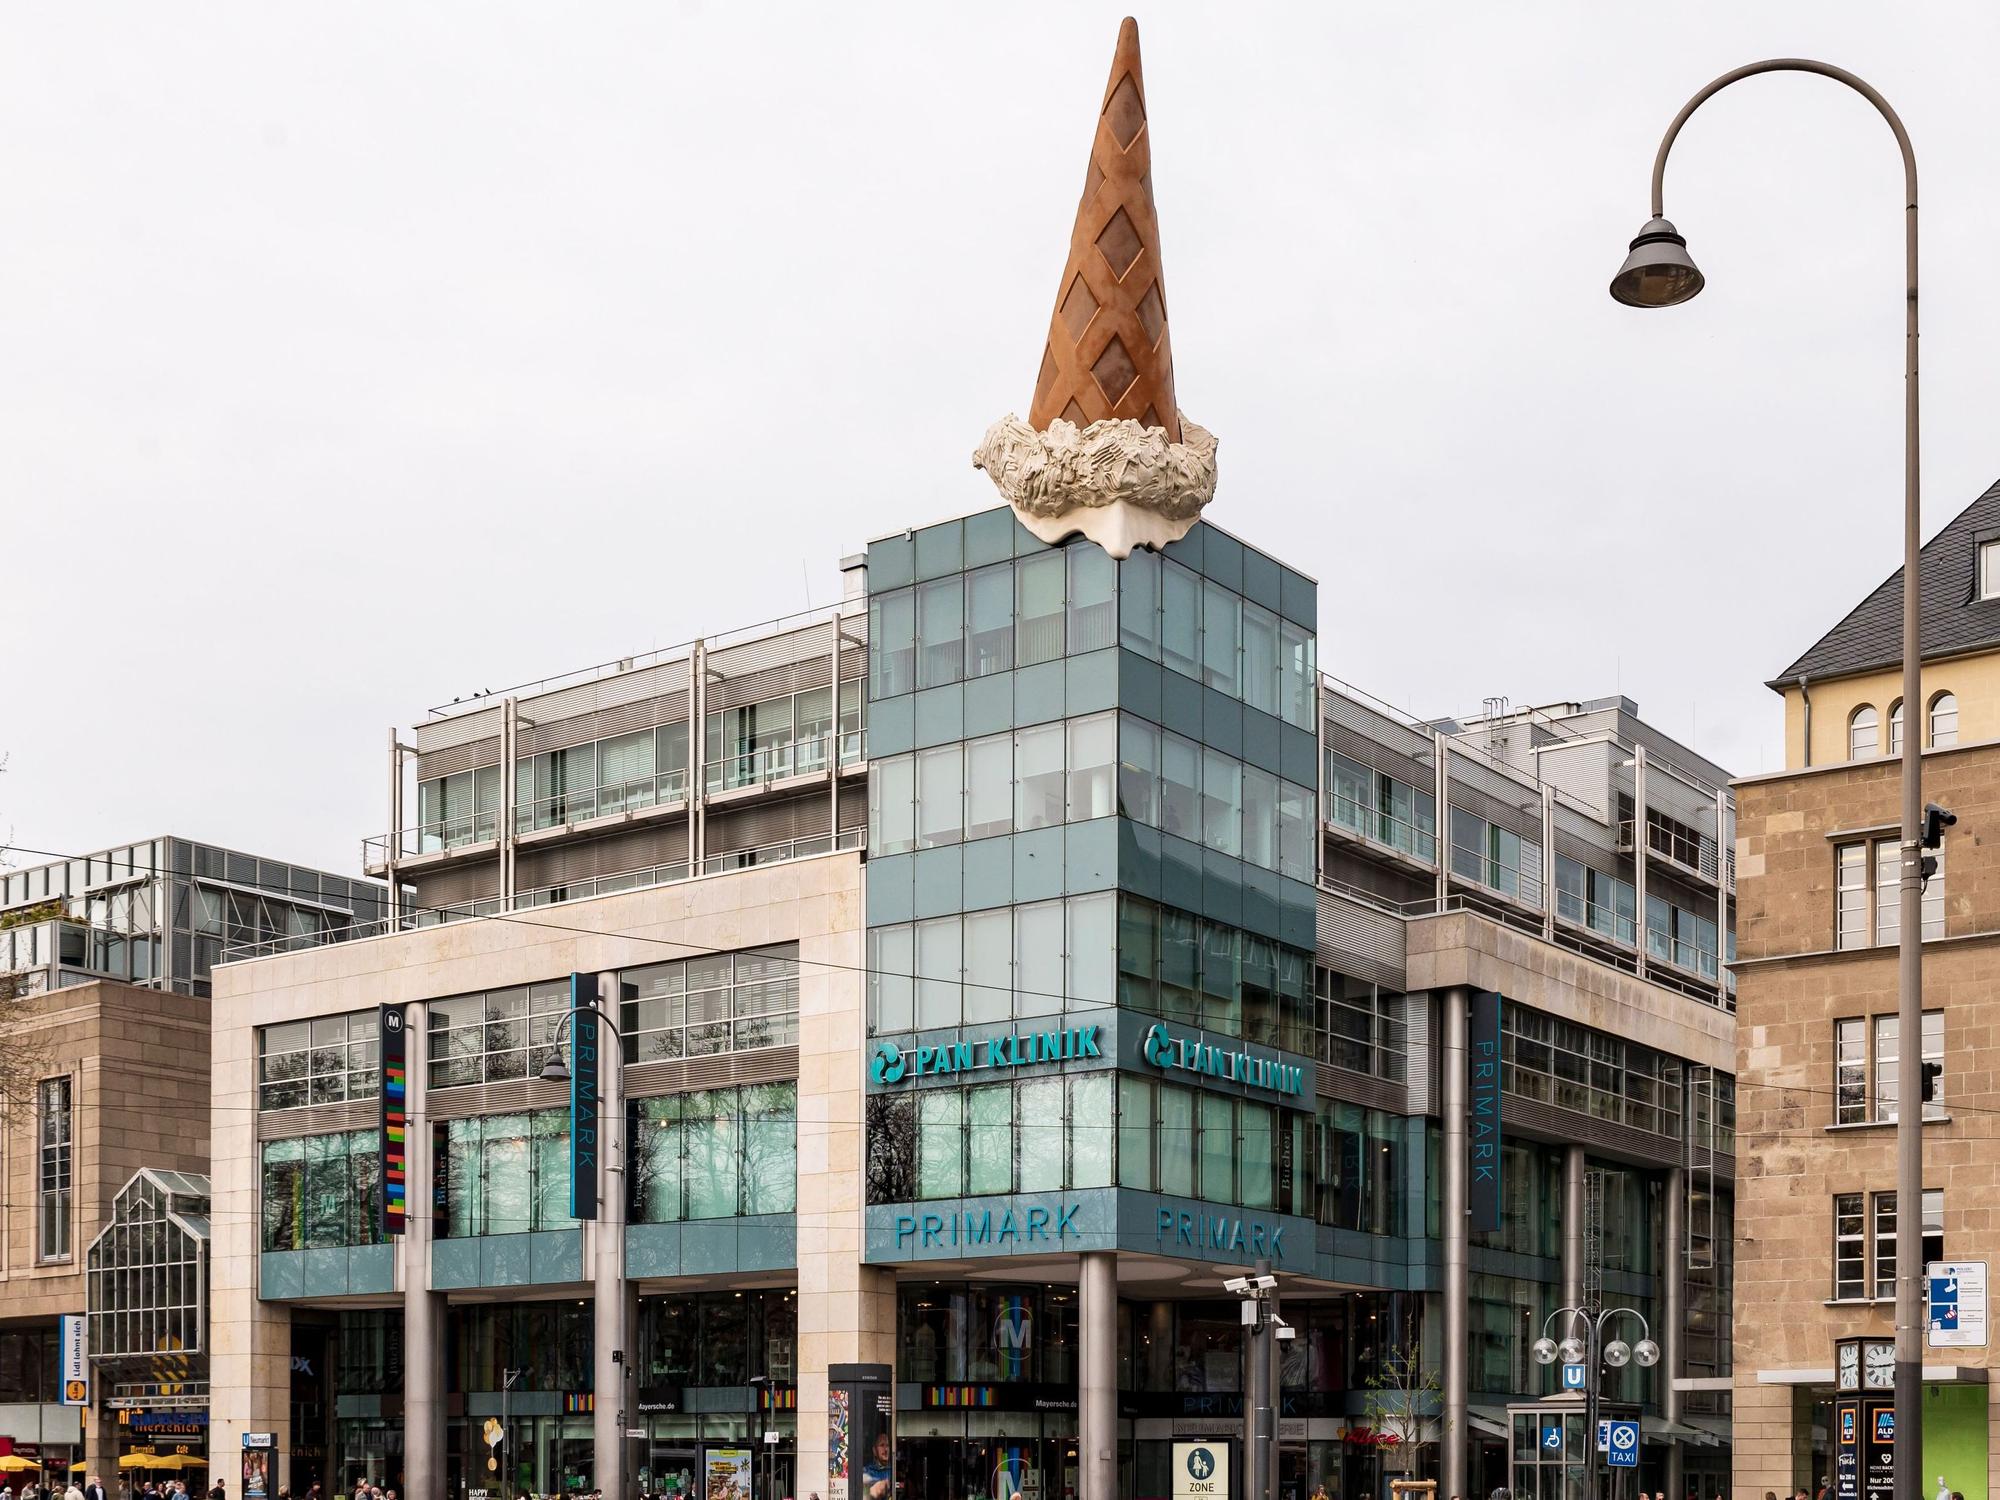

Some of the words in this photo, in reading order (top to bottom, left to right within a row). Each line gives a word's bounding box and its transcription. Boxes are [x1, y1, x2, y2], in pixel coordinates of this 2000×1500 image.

[387, 1013, 399, 1028] M
[916, 1039, 973, 1075] PAN
[987, 1025, 1101, 1068] KLINIK
[1180, 1038, 1223, 1077] PAN
[1231, 1050, 1305, 1097] KLINIK
[578, 1022, 595, 1169] PRIMARK
[1475, 1040, 1494, 1182] PRIMARK
[894, 1203, 1081, 1250] PRIMARK
[1156, 1206, 1286, 1260] PRIMARK
[73, 1320, 81, 1337] sich
[999, 1318, 1032, 1349] M
[73, 1339, 81, 1360] lohnt
[73, 1361, 81, 1377] Lidl
[1567, 1367, 1581, 1384] U
[1183, 1396, 1297, 1415] PRIMK
[1611, 1451, 1635, 1463] TAXI
[468, 1488, 489, 1497] HAPPY
[1189, 1482, 1215, 1492] ZONE
